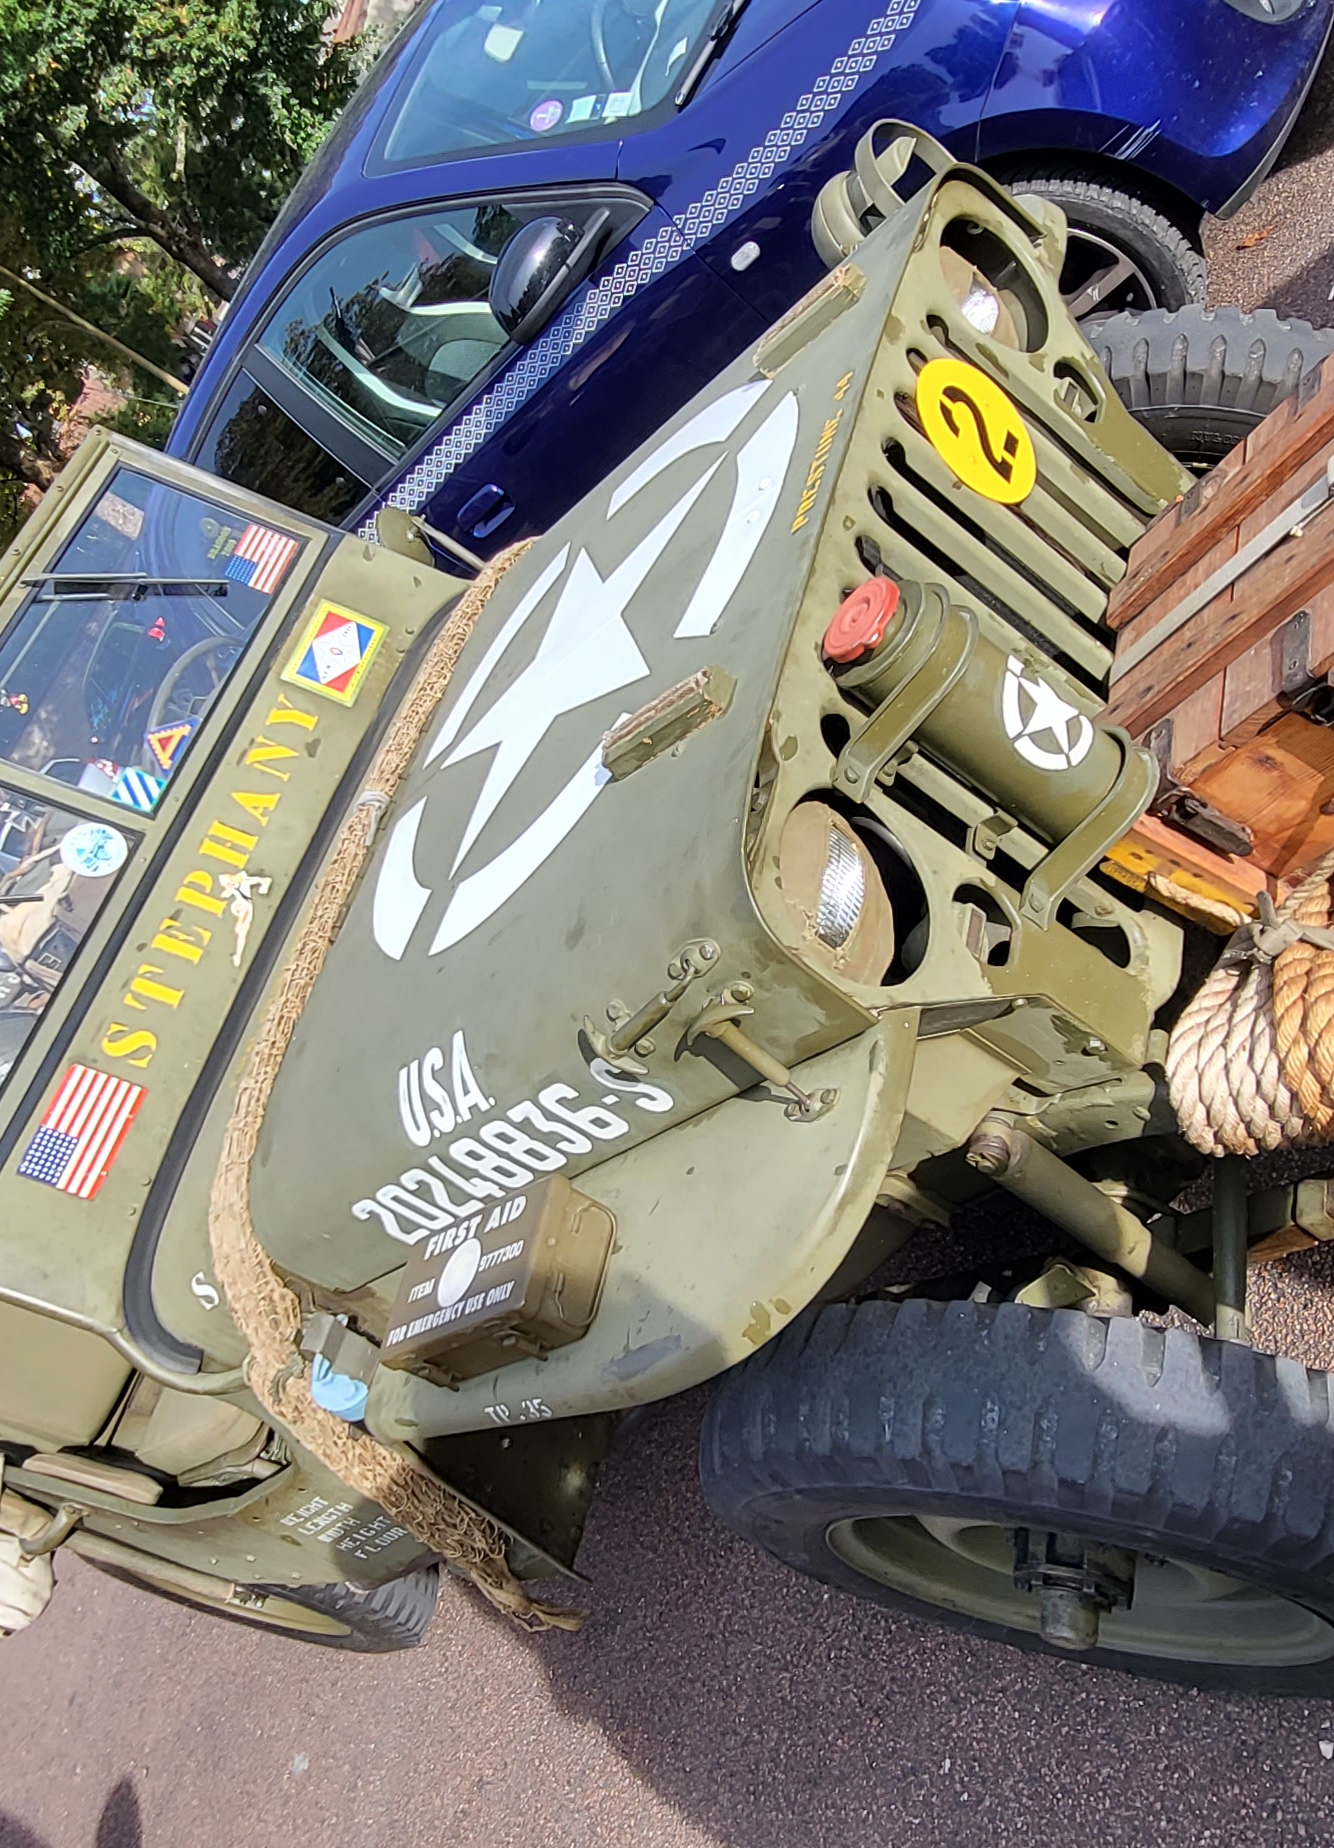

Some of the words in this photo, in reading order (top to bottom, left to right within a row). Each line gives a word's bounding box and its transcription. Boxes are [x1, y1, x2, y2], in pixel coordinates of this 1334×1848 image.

[939, 385, 1019, 483] 2
[101, 693, 319, 1068] STEPHANY
[397, 1030, 496, 1146] U.S.A.
[351, 1056, 674, 1246] 20248836-S
[424, 1212, 482, 1261] FIRST
[484, 1193, 525, 1233] AID
[407, 1277, 434, 1303] ITEM
[478, 1238, 523, 1272] 9777300
[387, 1325, 407, 1347] FOR
[407, 1300, 464, 1338] EMERGENCY
[465, 1292, 485, 1314] USE
[486, 1280, 515, 1306] ONLY
[297, 1500, 354, 1535] LENGTH
[317, 1515, 361, 1544] WIDTH
[336, 1514, 392, 1551] HEIGHT
[354, 1524, 408, 1559] FLOOR
